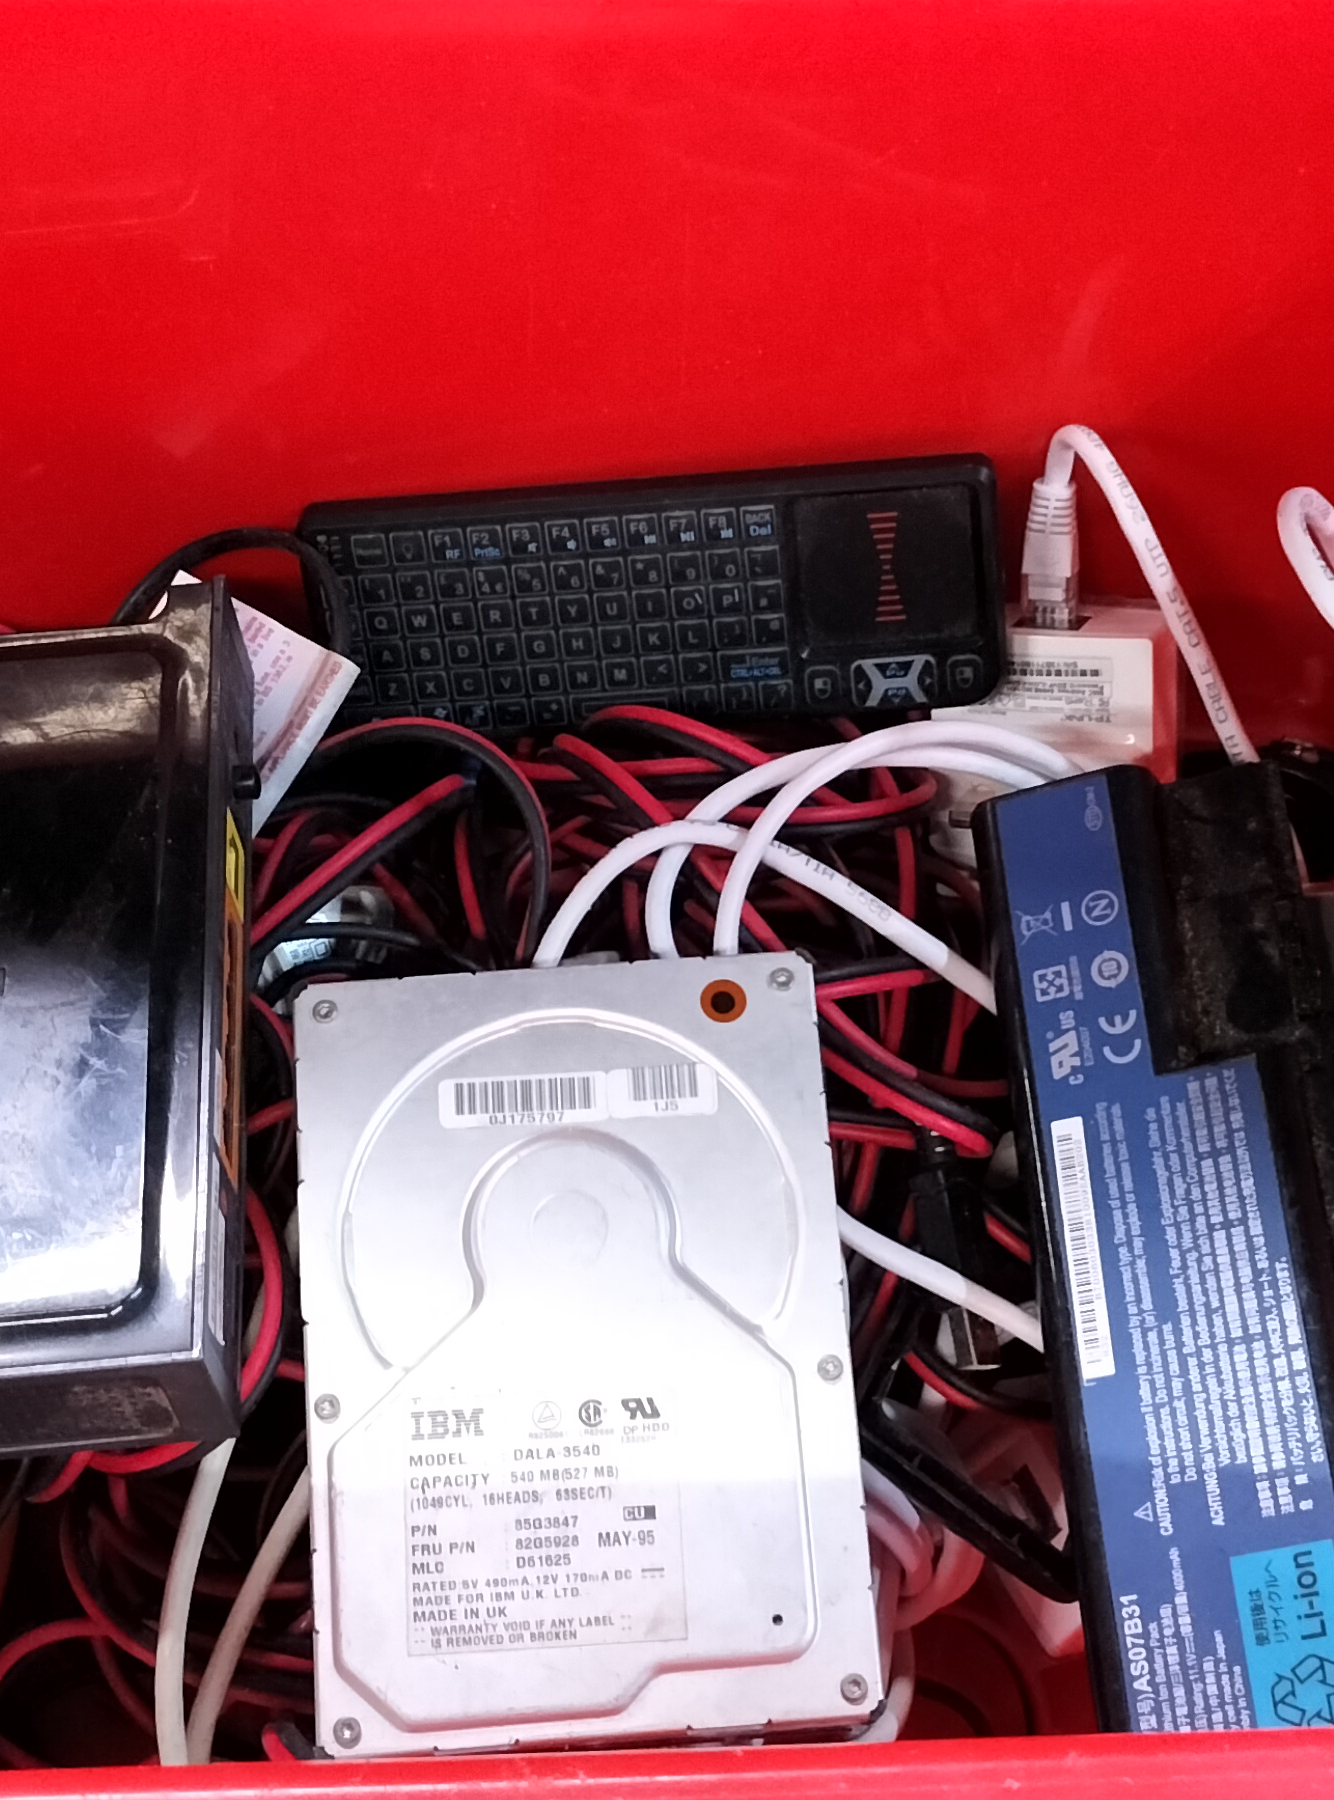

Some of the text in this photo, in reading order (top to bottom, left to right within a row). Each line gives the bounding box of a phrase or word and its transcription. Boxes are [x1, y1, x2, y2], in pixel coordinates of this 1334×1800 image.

[433, 515, 727, 547] F1 F2 F3 F4 F5 F6 F7 F8
[445, 549, 461, 559] RF
[1143, 536, 1170, 578] UTP
[1166, 587, 1203, 650] CAT.5
[843, 880, 894, 922] 568B
[1098, 1009, 1142, 1065] CE
[411, 1408, 484, 1441] IBM
[643, 1422, 670, 1433] HDD
[409, 1445, 600, 1467] MODEL DALA-3540
[410, 1473, 490, 1490] CAPACITY
[511, 1470, 534, 1483] 540
[594, 1465, 619, 1480] MB)
[411, 1525, 437, 1538] P/N
[411, 1543, 442, 1557] FRU
[449, 1541, 475, 1554] P/N
[598, 1530, 655, 1548] MAY-95
[413, 1579, 457, 1593] RATED
[462, 1578, 478, 1590] 5V
[536, 1574, 559, 1585] 12V
[614, 1569, 632, 1581] DC
[1293, 1549, 1328, 1641] Li-ion
[413, 1595, 451, 1607] MADE
[458, 1593, 484, 1604] FOR
[490, 1591, 515, 1602] IBM
[413, 1606, 508, 1623] MADE IN UK
[430, 1621, 498, 1637] WARRANTY
[503, 1620, 530, 1632] VOID
[550, 1617, 574, 1629] ANY
[579, 1615, 615, 1628] LABEL
[1248, 1587, 1270, 1646] 使用後は
[446, 1634, 504, 1648] REMOVED
[509, 1632, 525, 1644] OR
[530, 1630, 578, 1643] BROKEN
[1213, 1628, 1228, 1660] Japan
[1147, 1621, 1174, 1731] ithium Ion Battery Pack
[1220, 1673, 1233, 1702] made
[1231, 1664, 1245, 1695] China
[1224, 1703, 1236, 1722] cell
